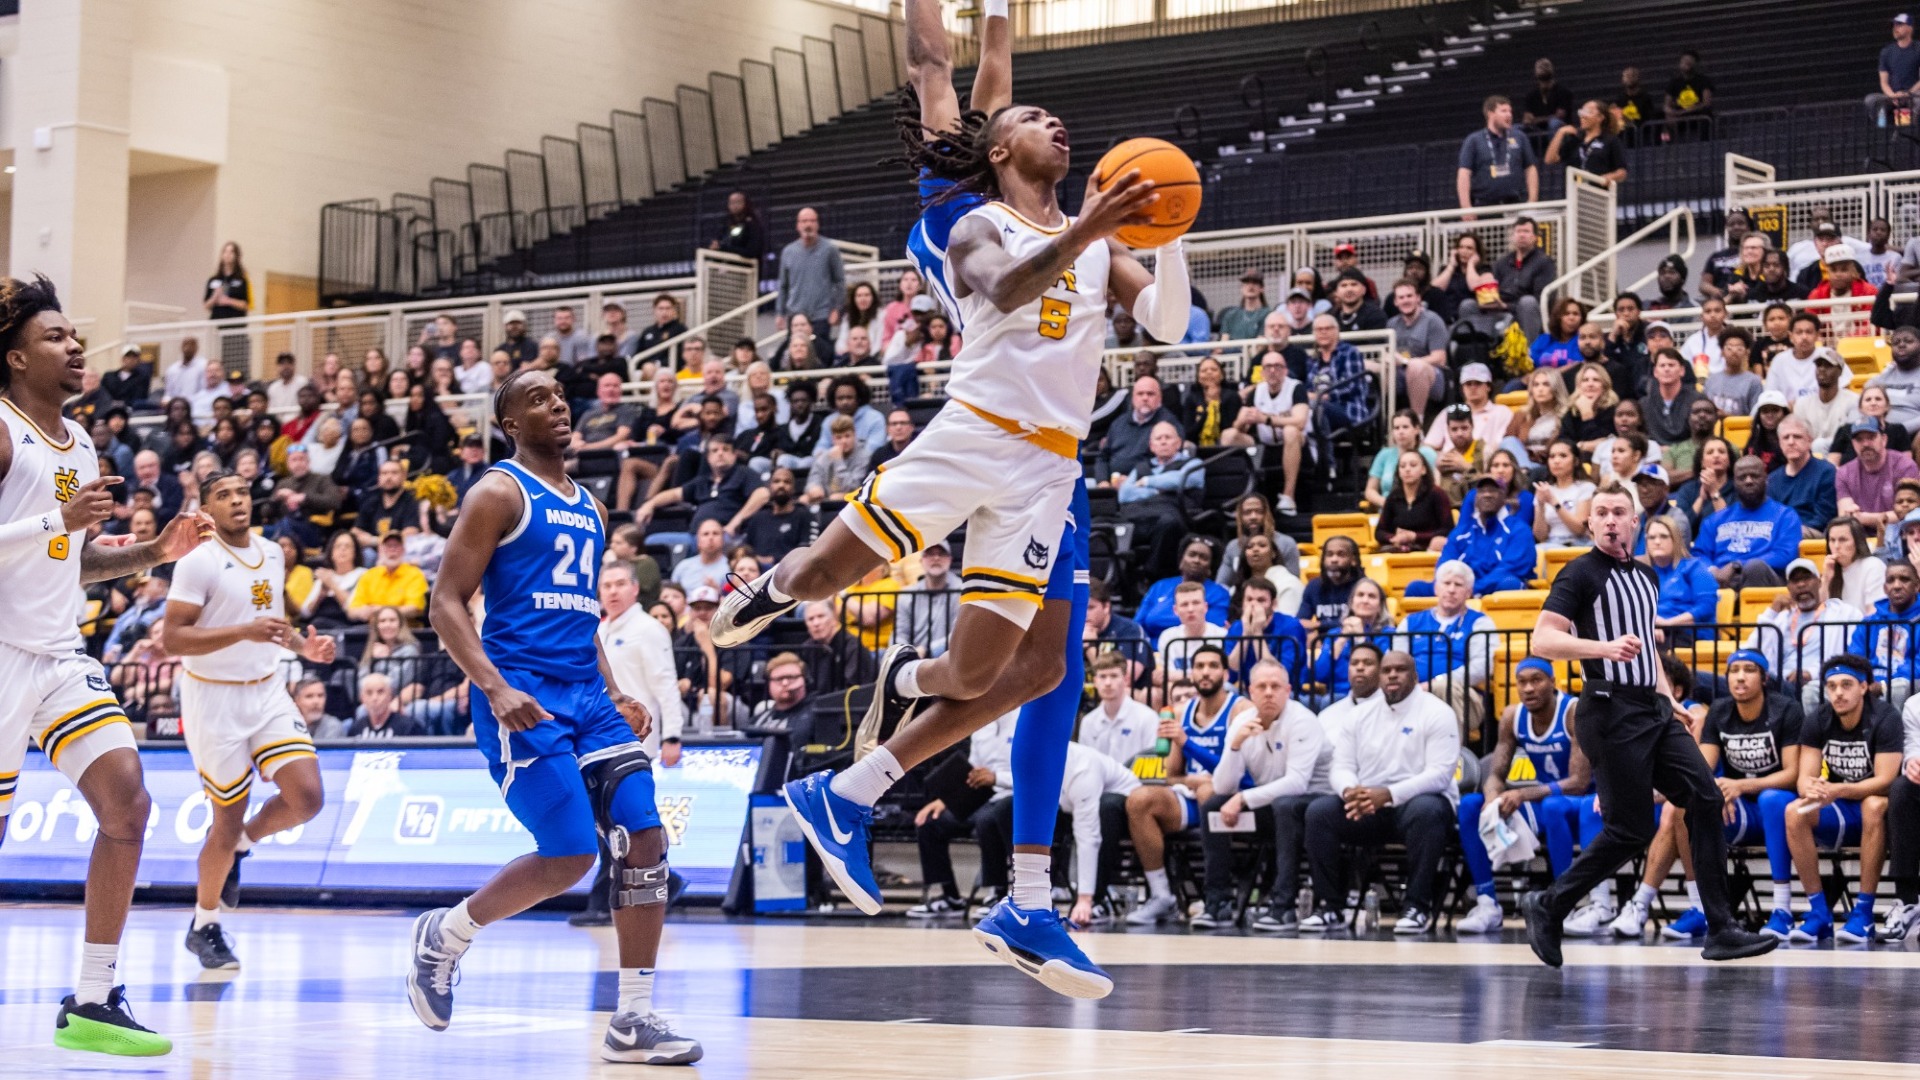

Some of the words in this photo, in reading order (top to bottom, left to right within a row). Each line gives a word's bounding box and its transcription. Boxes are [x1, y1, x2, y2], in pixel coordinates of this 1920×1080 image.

[1759, 219, 1779, 231] 103
[1038, 296, 1072, 340] 5
[545, 508, 597, 533] MIDDLE
[551, 532, 594, 590] 24
[1724, 746, 1772, 760] HISTORY
[1727, 738, 1766, 750] BLACK
[1828, 745, 1865, 757] BLACK
[1544, 754, 1560, 780] 4
